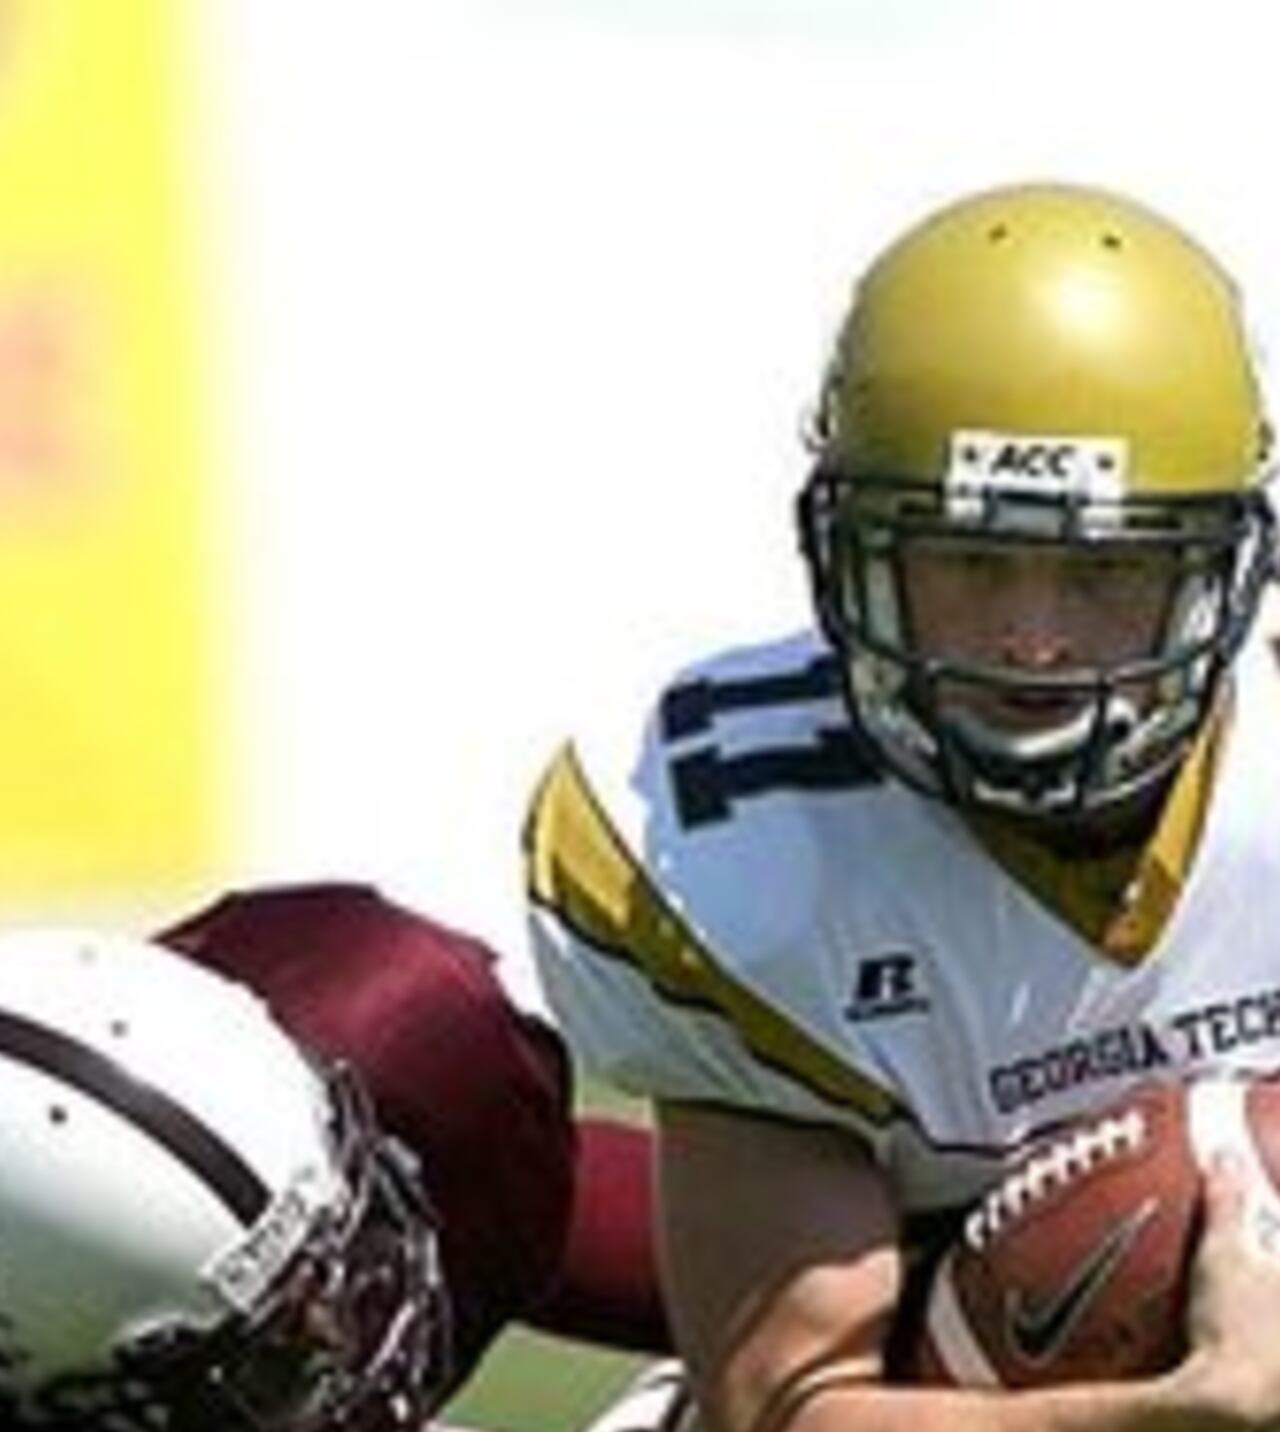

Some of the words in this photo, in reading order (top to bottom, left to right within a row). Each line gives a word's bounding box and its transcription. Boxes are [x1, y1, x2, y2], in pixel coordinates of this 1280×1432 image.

[990, 443, 1076, 478] ACC
[660, 651, 882, 835] 11
[990, 1022, 1169, 1115] GEORGIA
